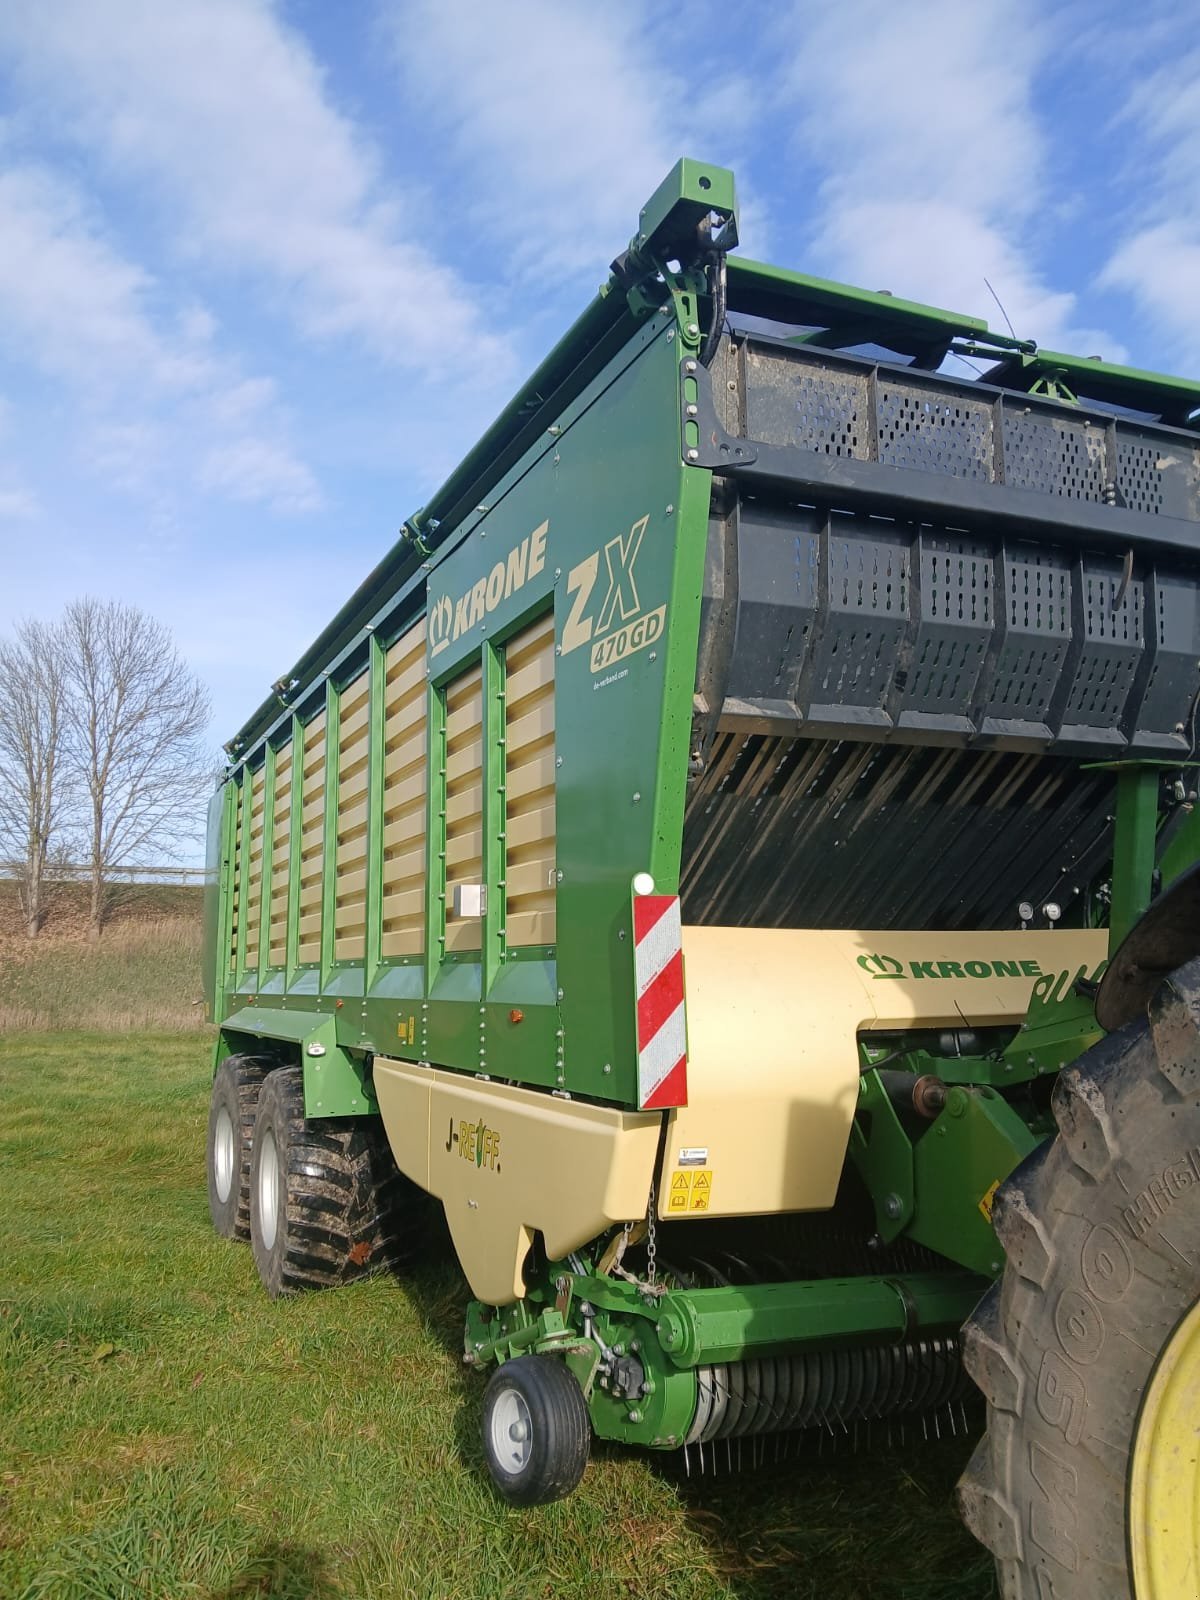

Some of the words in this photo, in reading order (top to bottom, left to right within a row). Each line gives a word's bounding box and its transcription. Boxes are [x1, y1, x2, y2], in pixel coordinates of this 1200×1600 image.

[452, 519, 549, 642] KRONE
[561, 513, 650, 657] ZX
[593, 633, 626, 667] 470
[629, 613, 660, 649] GD
[909, 959, 1043, 979] KRONE
